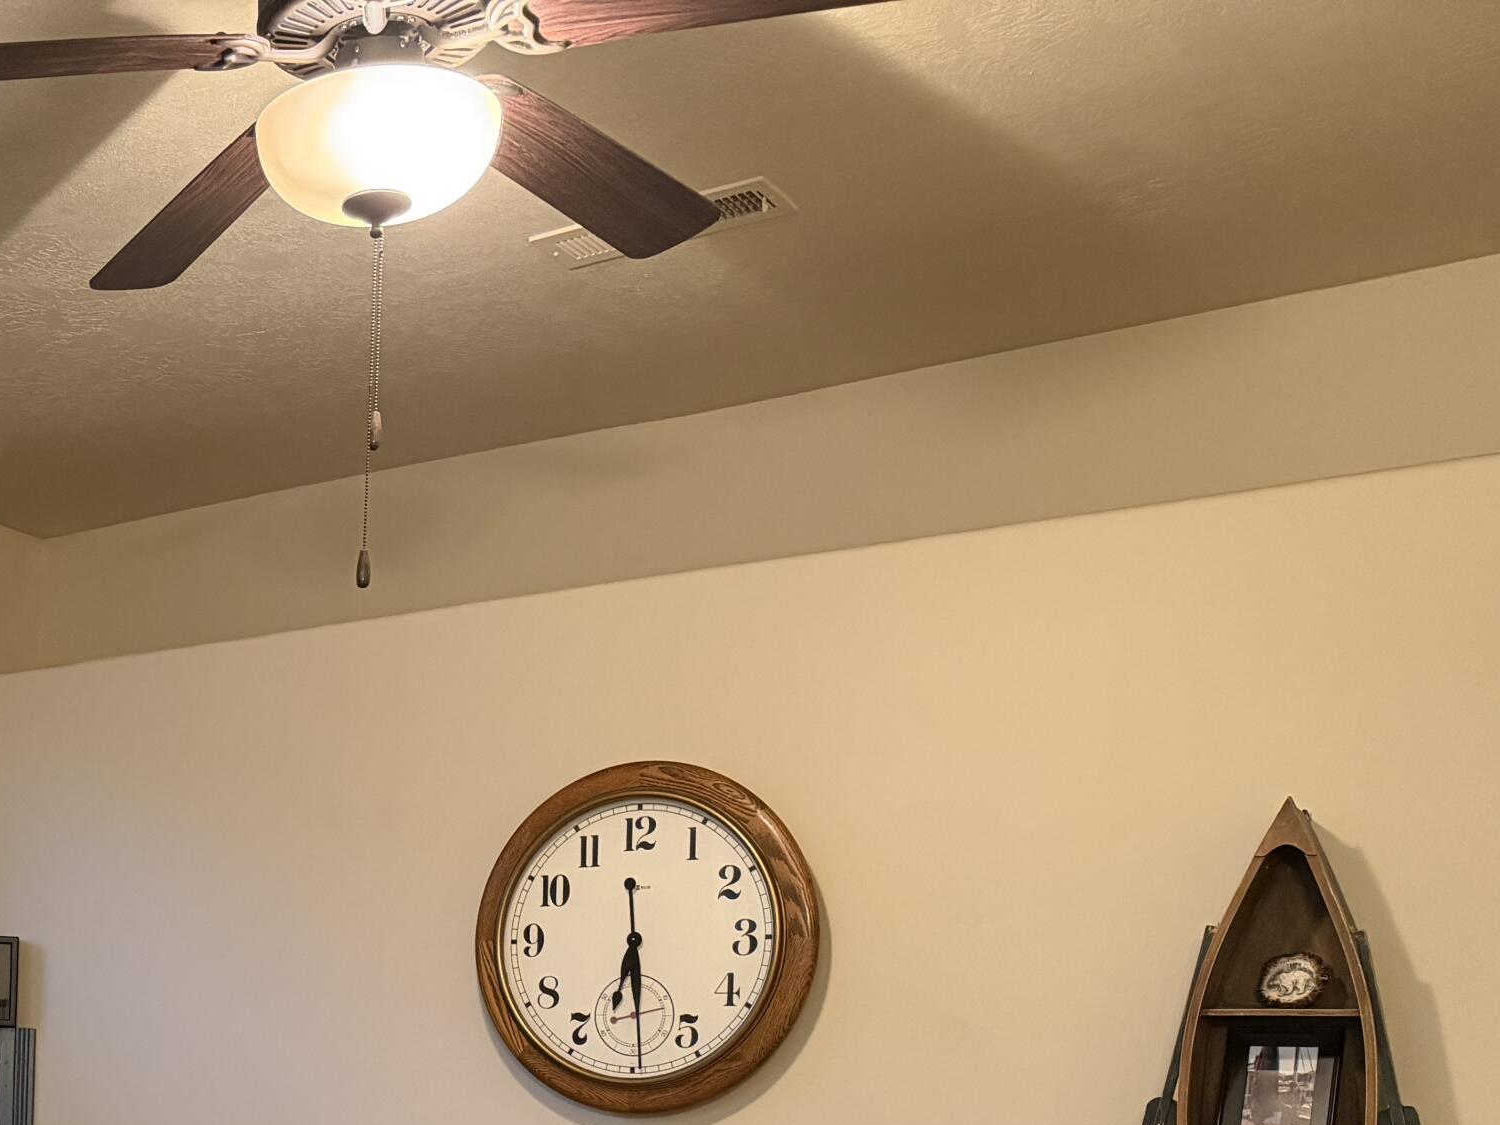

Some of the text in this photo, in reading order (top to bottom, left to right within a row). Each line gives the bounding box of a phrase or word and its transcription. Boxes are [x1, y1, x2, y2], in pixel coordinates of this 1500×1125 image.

[578, 834, 601, 868] 11
[623, 816, 657, 852] 12
[686, 827, 700, 861] 1
[539, 873, 571, 907] 10
[717, 864, 742, 900] 2
[523, 923, 545, 958] 9
[732, 918, 758, 956] 3
[537, 975, 560, 1010] 8
[713, 972, 741, 1007] 4
[570, 1012, 591, 1046] 7
[675, 1013, 700, 1049] 5
